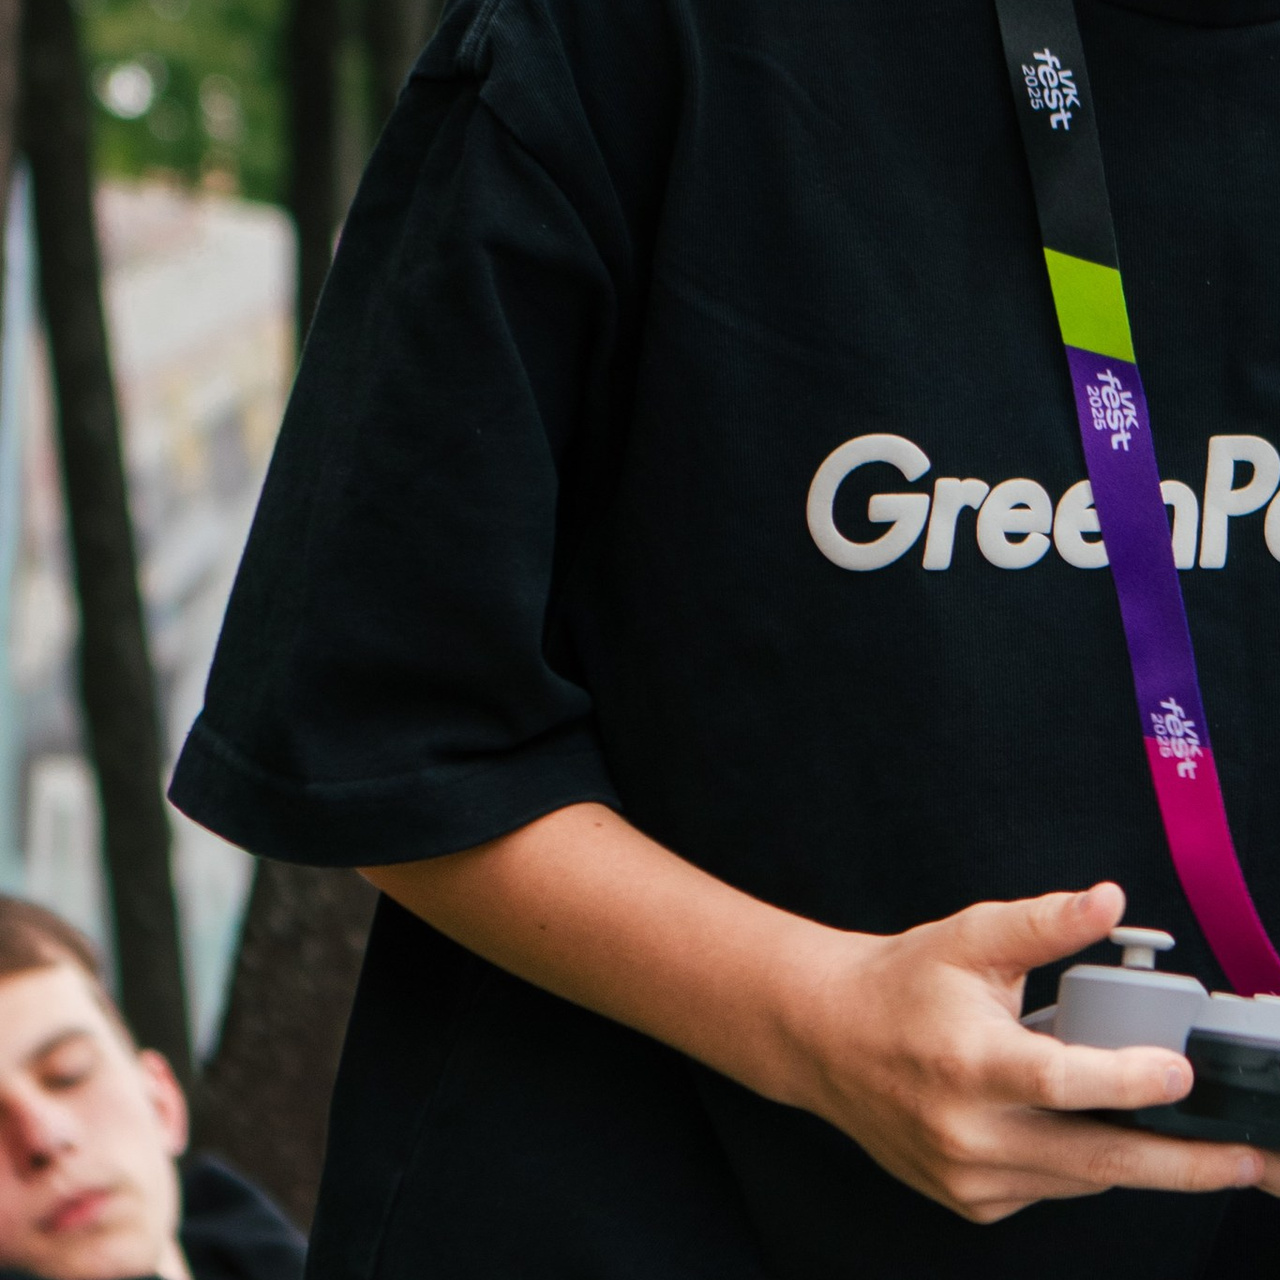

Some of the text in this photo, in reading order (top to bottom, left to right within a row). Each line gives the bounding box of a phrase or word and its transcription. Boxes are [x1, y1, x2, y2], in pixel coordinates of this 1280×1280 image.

[1021, 64, 1044, 111] 2025
[1032, 47, 1072, 131] fest
[1058, 69, 1081, 109] VK
[1086, 384, 1107, 431] 2025
[1096, 368, 1132, 452] fest
[1119, 391, 1140, 430] VK
[1160, 696, 1198, 780] fest
[1182, 720, 1204, 757] VK
